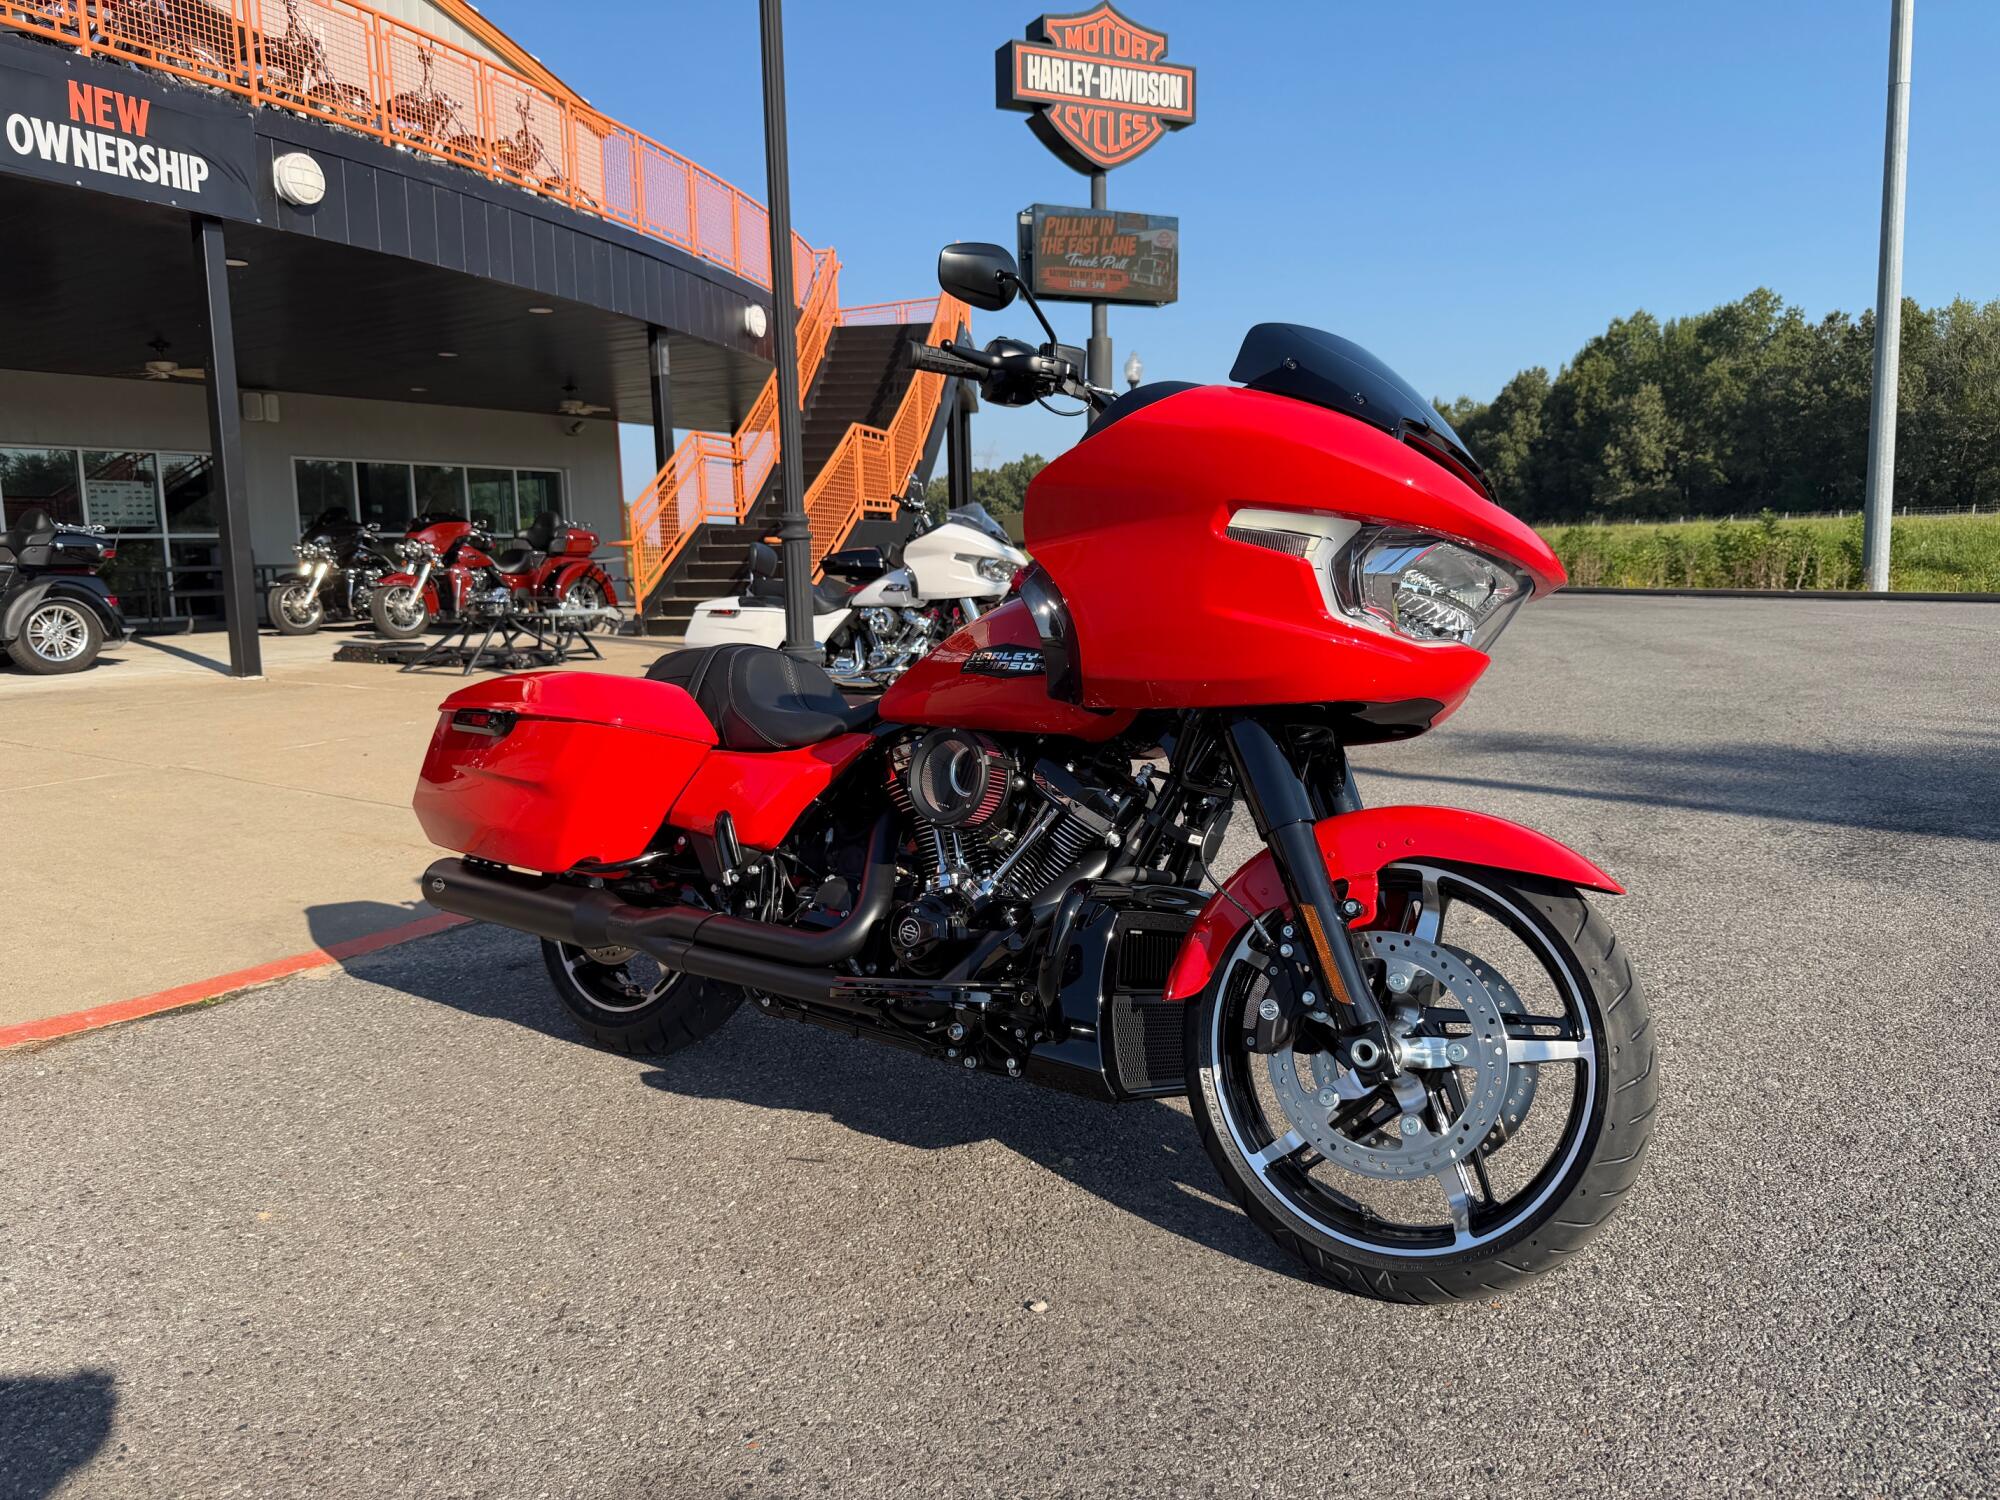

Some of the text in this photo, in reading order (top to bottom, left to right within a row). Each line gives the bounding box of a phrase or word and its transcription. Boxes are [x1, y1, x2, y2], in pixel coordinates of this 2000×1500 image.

[1065, 17, 1147, 61] MOTOR
[1027, 54, 1183, 108] HARLEY-DAVIDSON
[67, 79, 151, 137] NEW
[1065, 105, 1148, 153] CYCLES
[6, 113, 209, 193] OWNERSHIP
[1041, 235, 1065, 255] THE
[1102, 236, 1137, 256] LANE
[1045, 217, 1115, 236] PULLIN' IN
[1065, 253, 1130, 270] Truck Pull
